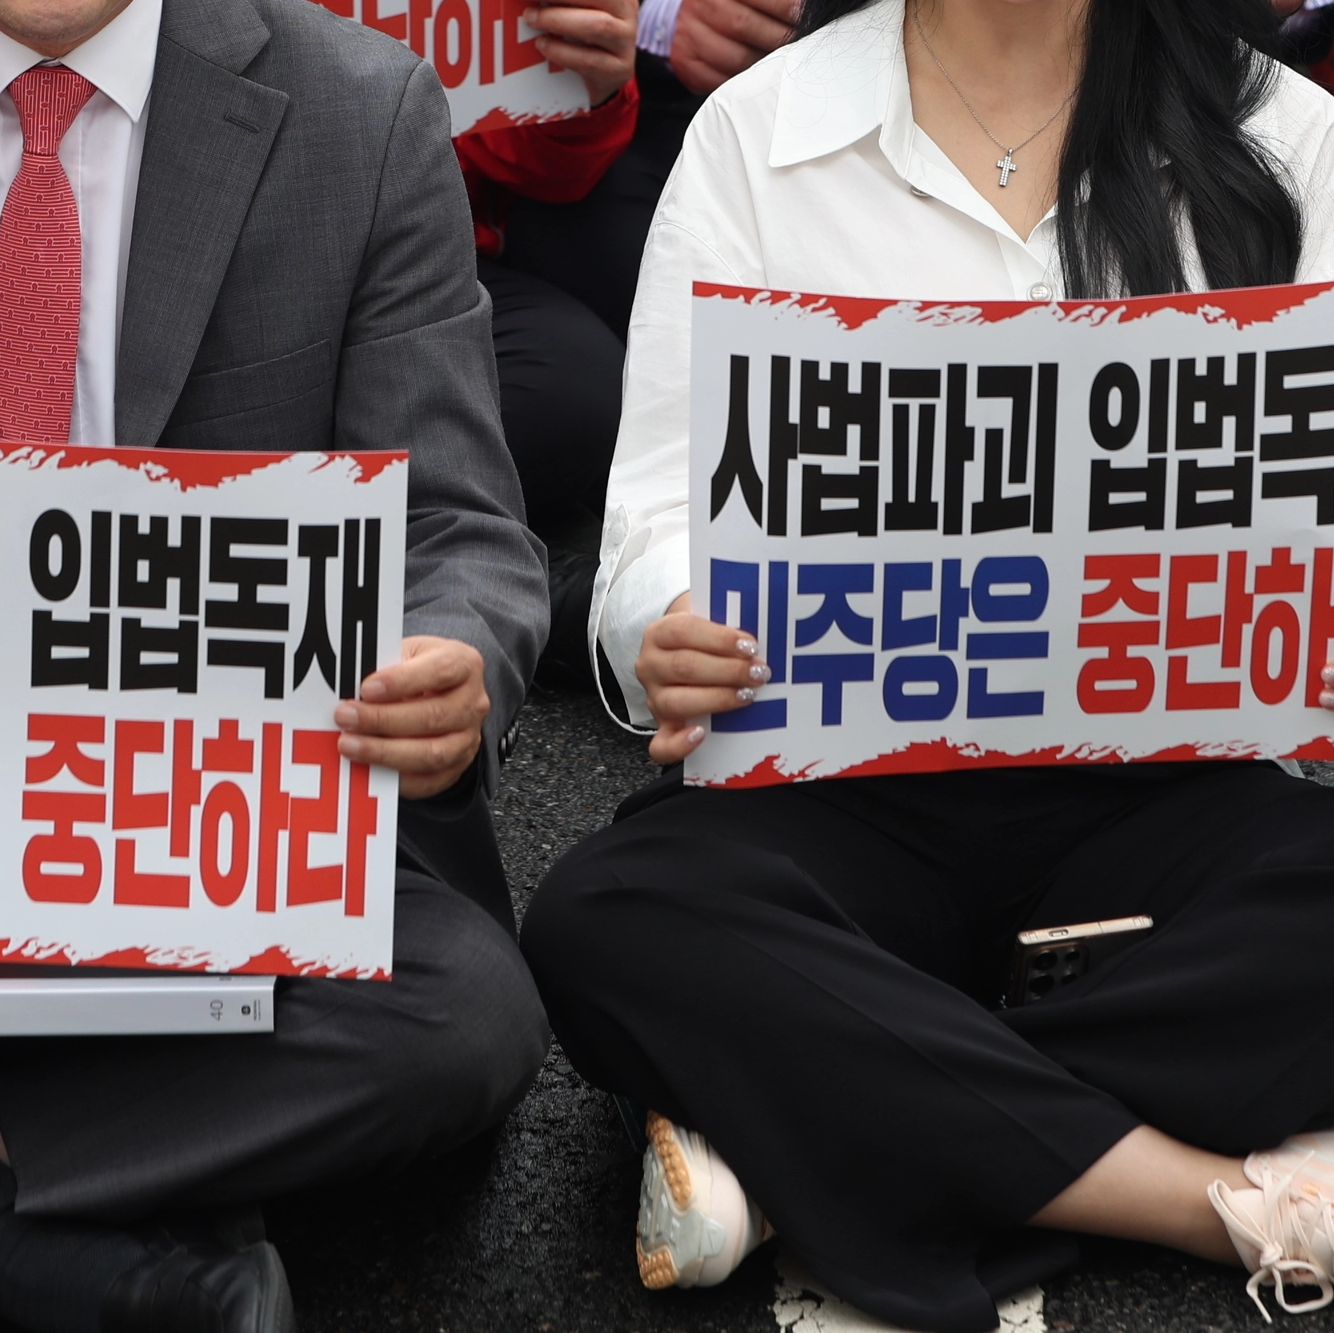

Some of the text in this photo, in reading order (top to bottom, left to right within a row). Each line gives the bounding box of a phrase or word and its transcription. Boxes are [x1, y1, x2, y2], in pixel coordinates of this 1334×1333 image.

[710, 353, 1059, 538] 사법파괴
[28, 507, 382, 700] 입법독재
[709, 555, 1050, 733] 민주당은
[21, 711, 379, 918] 중단하라
